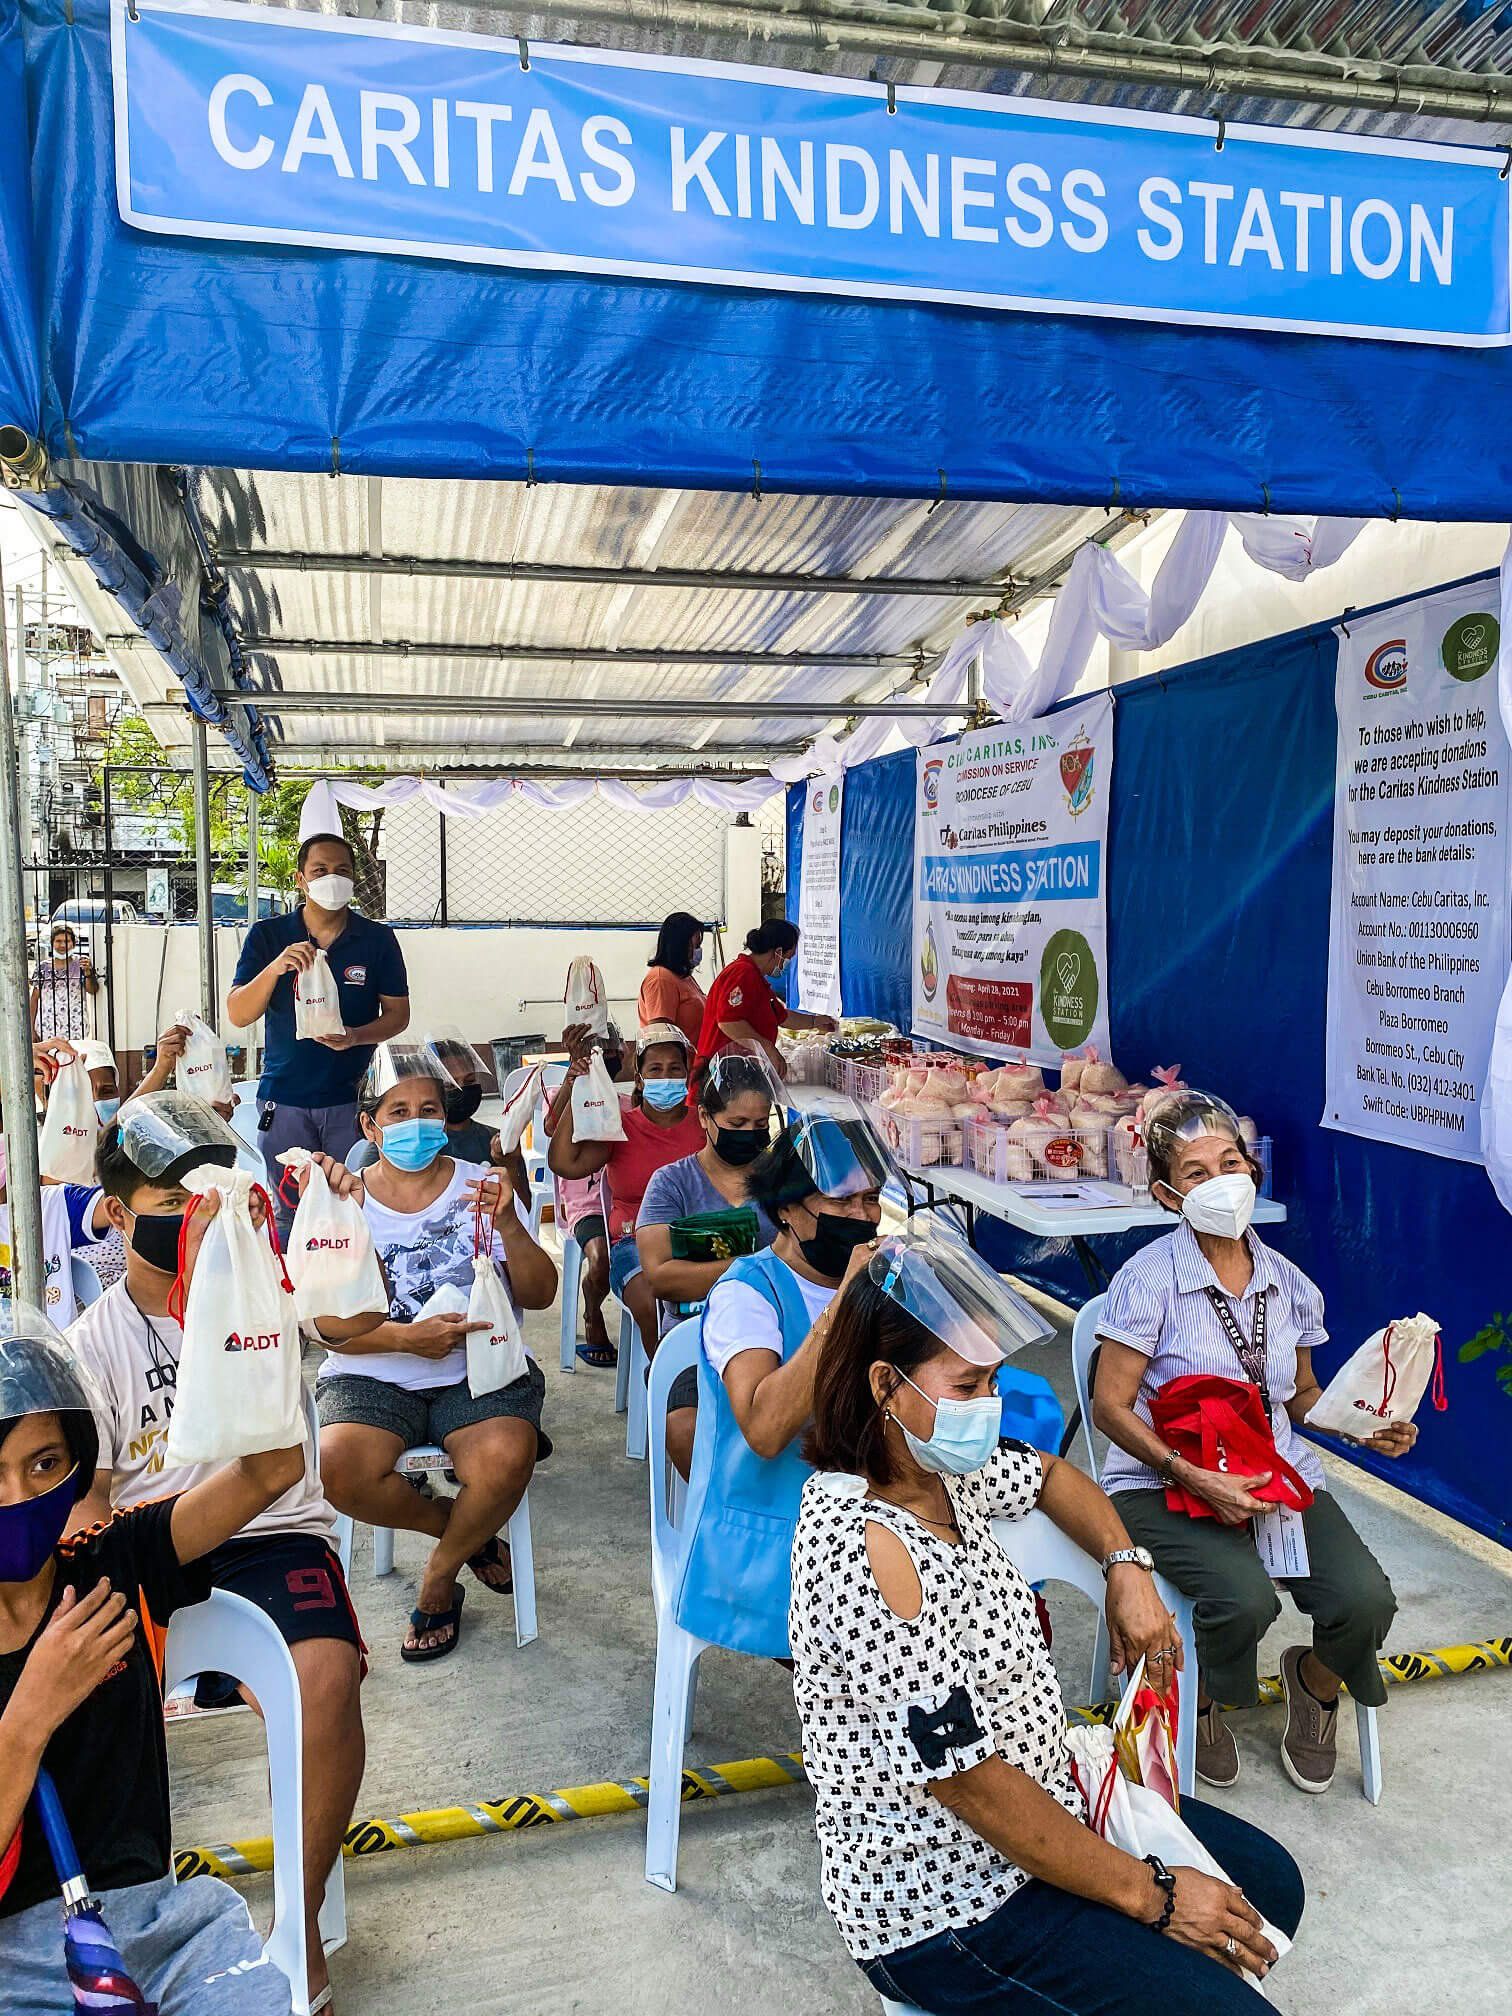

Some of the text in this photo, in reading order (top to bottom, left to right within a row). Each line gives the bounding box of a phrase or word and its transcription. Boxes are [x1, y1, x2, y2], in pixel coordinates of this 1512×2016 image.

[208, 73, 1454, 286] CARITAS KINDNESS STATION
[1359, 706, 1486, 746] To those who wish to help,
[966, 739, 1025, 762] CARITAS,
[1354, 739, 1487, 774] we are accepting donations
[992, 764, 1004, 777] ON
[1005, 758, 1040, 775] SERVICE
[1360, 783, 1375, 801] the
[1378, 780, 1414, 799] Caritas
[1417, 774, 1460, 796] Kindness
[1462, 767, 1499, 790] Station
[959, 818, 1047, 841] Caritas Philippines
[1348, 819, 1497, 846] You may deposit your donations,
[1358, 844, 1475, 864] here are the bank details:
[1025, 854, 1089, 891] STATION
[1351, 889, 1490, 910] Account Name: Cebu Caritas, Inc.
[1358, 921, 1479, 940] Account No.: 001130006960
[1356, 949, 1480, 975] Union Bank of the Philippines
[1002, 986, 1020, 997] 2021
[1053, 994, 1084, 1010] KINDNESS
[1366, 979, 1465, 1004] Cebu Borromeo Branch
[1018, 1019, 1029, 1029] pm
[1052, 1007, 1083, 1019] STATION
[1379, 1010, 1448, 1034] Plaza Borromeo
[960, 1022, 984, 1038] Monday
[990, 1028, 1010, 1042] Friday
[1365, 1038, 1465, 1072] Borromeo St., Cebu City
[195, 1063, 213, 1073] PLDT
[1357, 1065, 1476, 1102] Bank Tel. No. (032) 412-3401
[1362, 1095, 1465, 1132] Swift Code: UBPHPHMM
[319, 1238, 351, 1250] PLDT
[1214, 1298, 1244, 1348] Jesus
[1255, 1292, 1265, 1344] Jesus
[285, 1568, 337, 1611] 9
